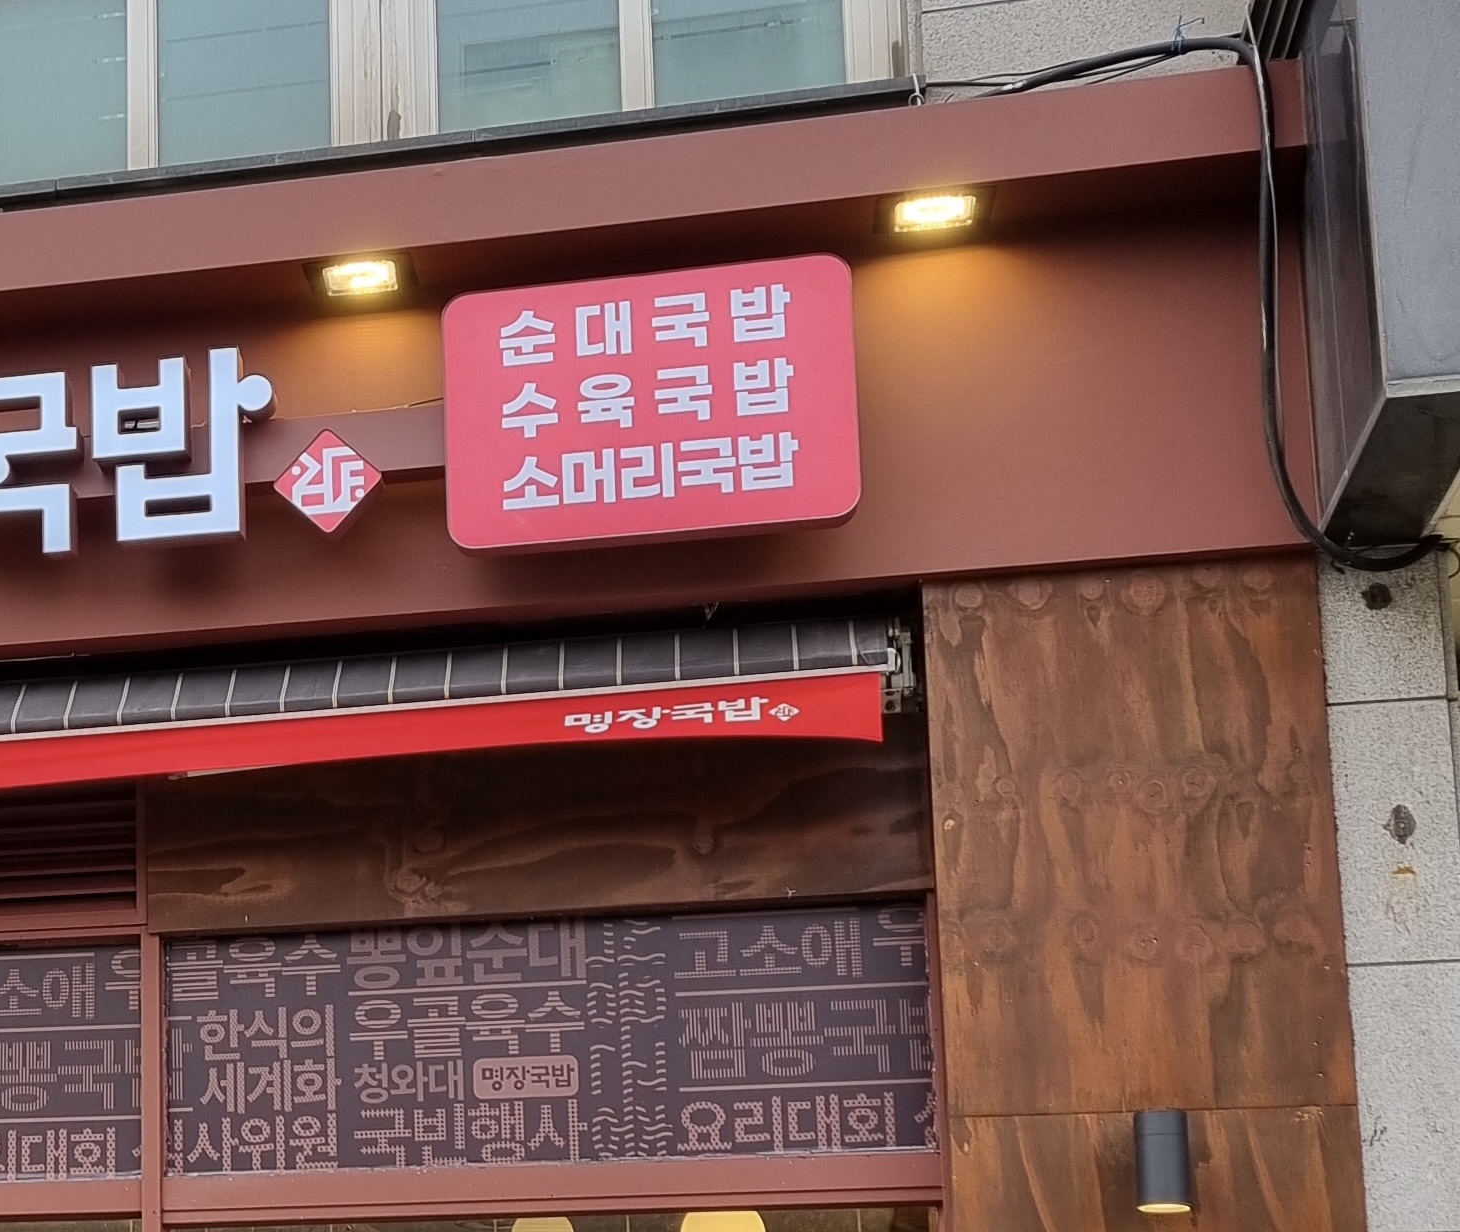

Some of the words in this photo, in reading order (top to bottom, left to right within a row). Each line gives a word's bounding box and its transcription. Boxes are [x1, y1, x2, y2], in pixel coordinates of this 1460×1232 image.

[502, 432, 799, 511] 소머리국밥
[564, 697, 769, 733] 명장국밥
[347, 915, 586, 989] 뽕잎순대
[674, 917, 864, 978] 고소애
[196, 1004, 336, 1062] 한식의
[349, 990, 585, 1061] 우골육수
[200, 1057, 342, 1114] 세계화
[353, 1059, 465, 1104] 청와대
[481, 1063, 575, 1092] 명장국밥
[677, 1092, 895, 1154] 요리대회
